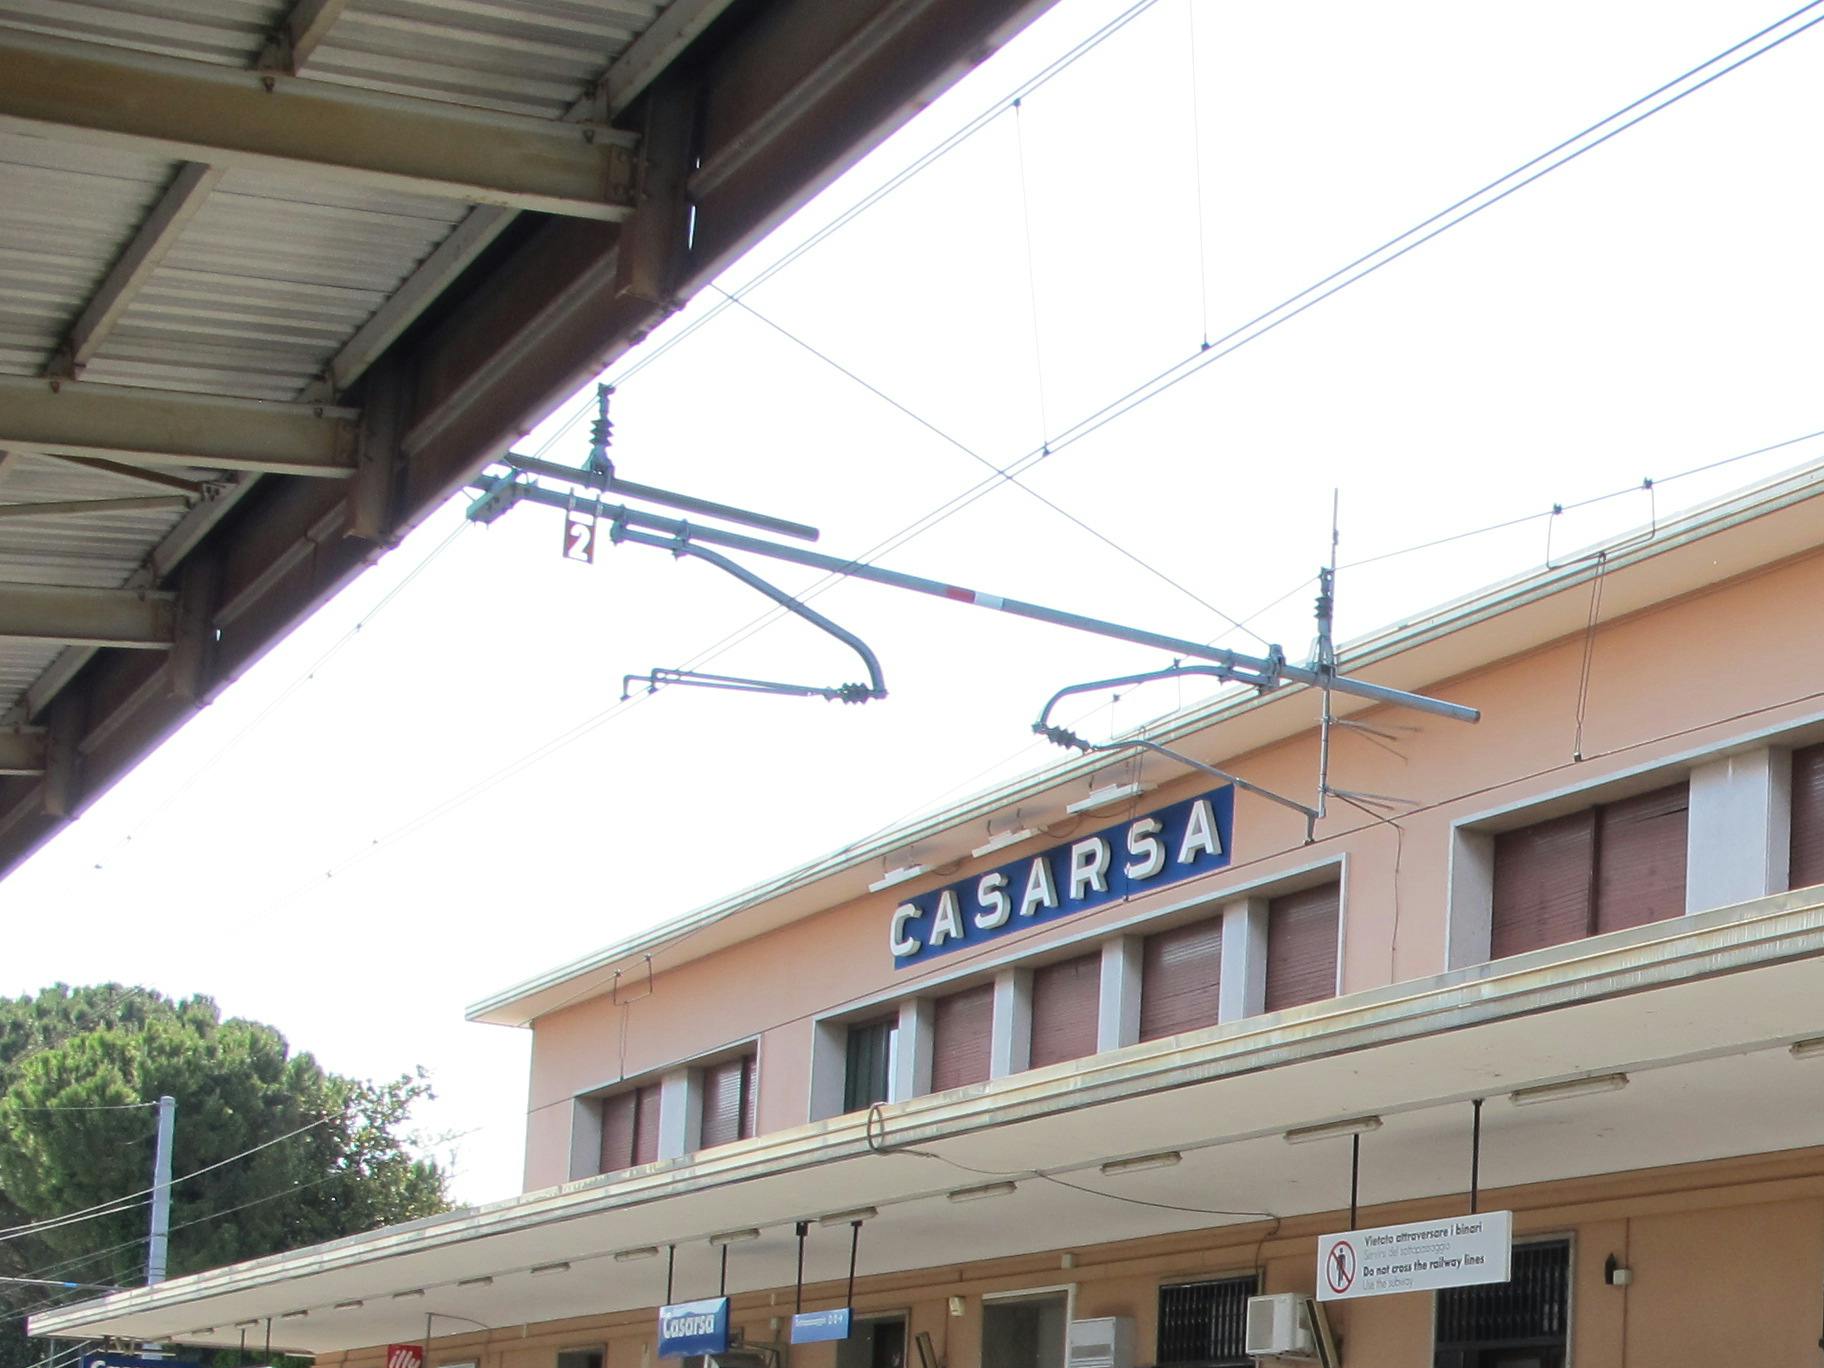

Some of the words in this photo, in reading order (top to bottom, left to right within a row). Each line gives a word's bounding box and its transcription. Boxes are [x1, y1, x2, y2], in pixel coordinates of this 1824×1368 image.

[568, 523, 591, 561] 2
[889, 799, 1223, 958] CASARSA
[1364, 1235, 1394, 1247] Vietato
[1396, 1228, 1449, 1243] attraversare
[1455, 1221, 1483, 1236] binari
[1363, 1265, 1375, 1277] Do
[1376, 1265, 1390, 1275] not
[1391, 1263, 1412, 1273] cross
[1414, 1259, 1428, 1271] the
[1429, 1256, 1462, 1270] railway
[1464, 1253, 1486, 1265] lines
[663, 1311, 715, 1340] Casarsa
